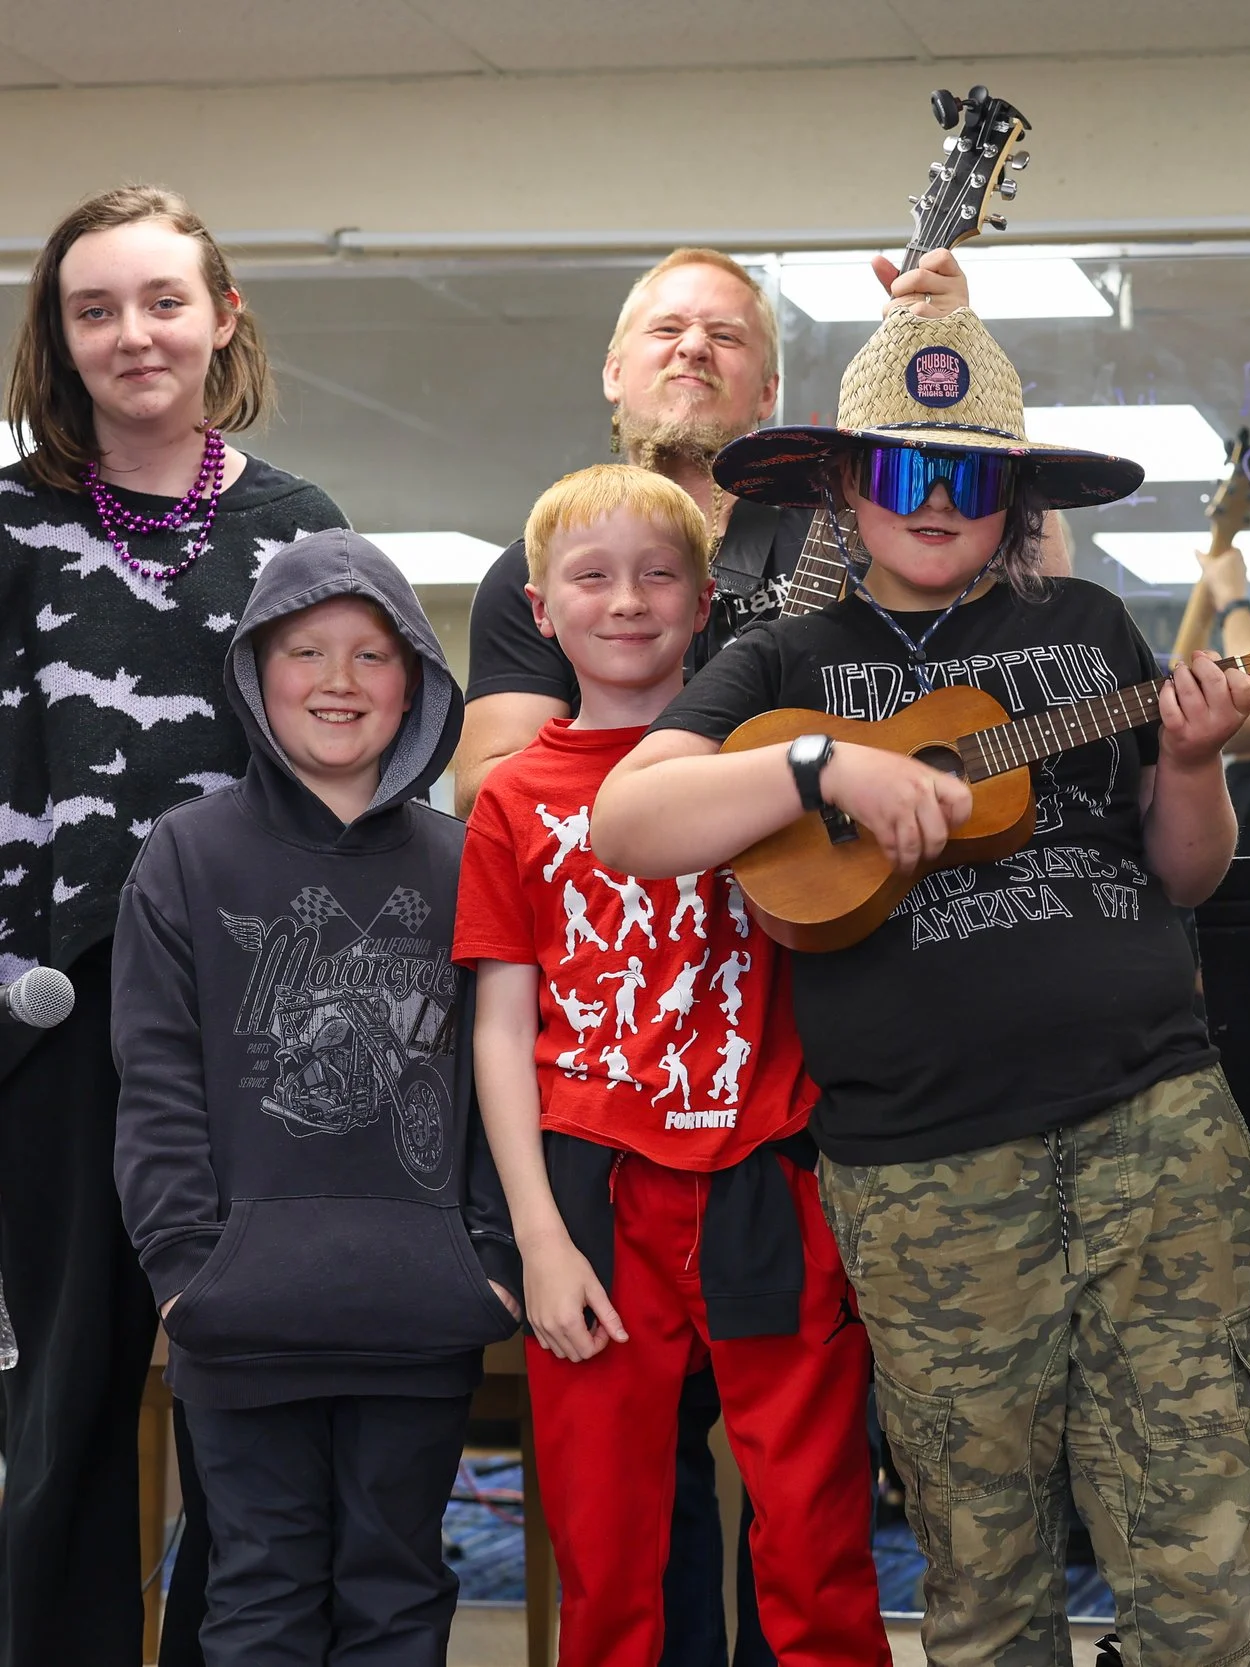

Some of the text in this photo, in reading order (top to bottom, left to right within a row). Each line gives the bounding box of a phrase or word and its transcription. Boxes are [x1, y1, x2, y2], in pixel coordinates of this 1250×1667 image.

[916, 353, 960, 373] CHUBBIES
[917, 383, 941, 391] SKY'S
[888, 865, 977, 920] NITED
[996, 847, 1118, 882] STATES
[912, 883, 1140, 950] AMERICA 1977
[363, 937, 432, 955] CALIFORNIA
[246, 1043, 271, 1054] PARTS
[252, 1059, 270, 1071] AND
[238, 1077, 270, 1089] SERVICE
[665, 1109, 738, 1130] FORTNITE
